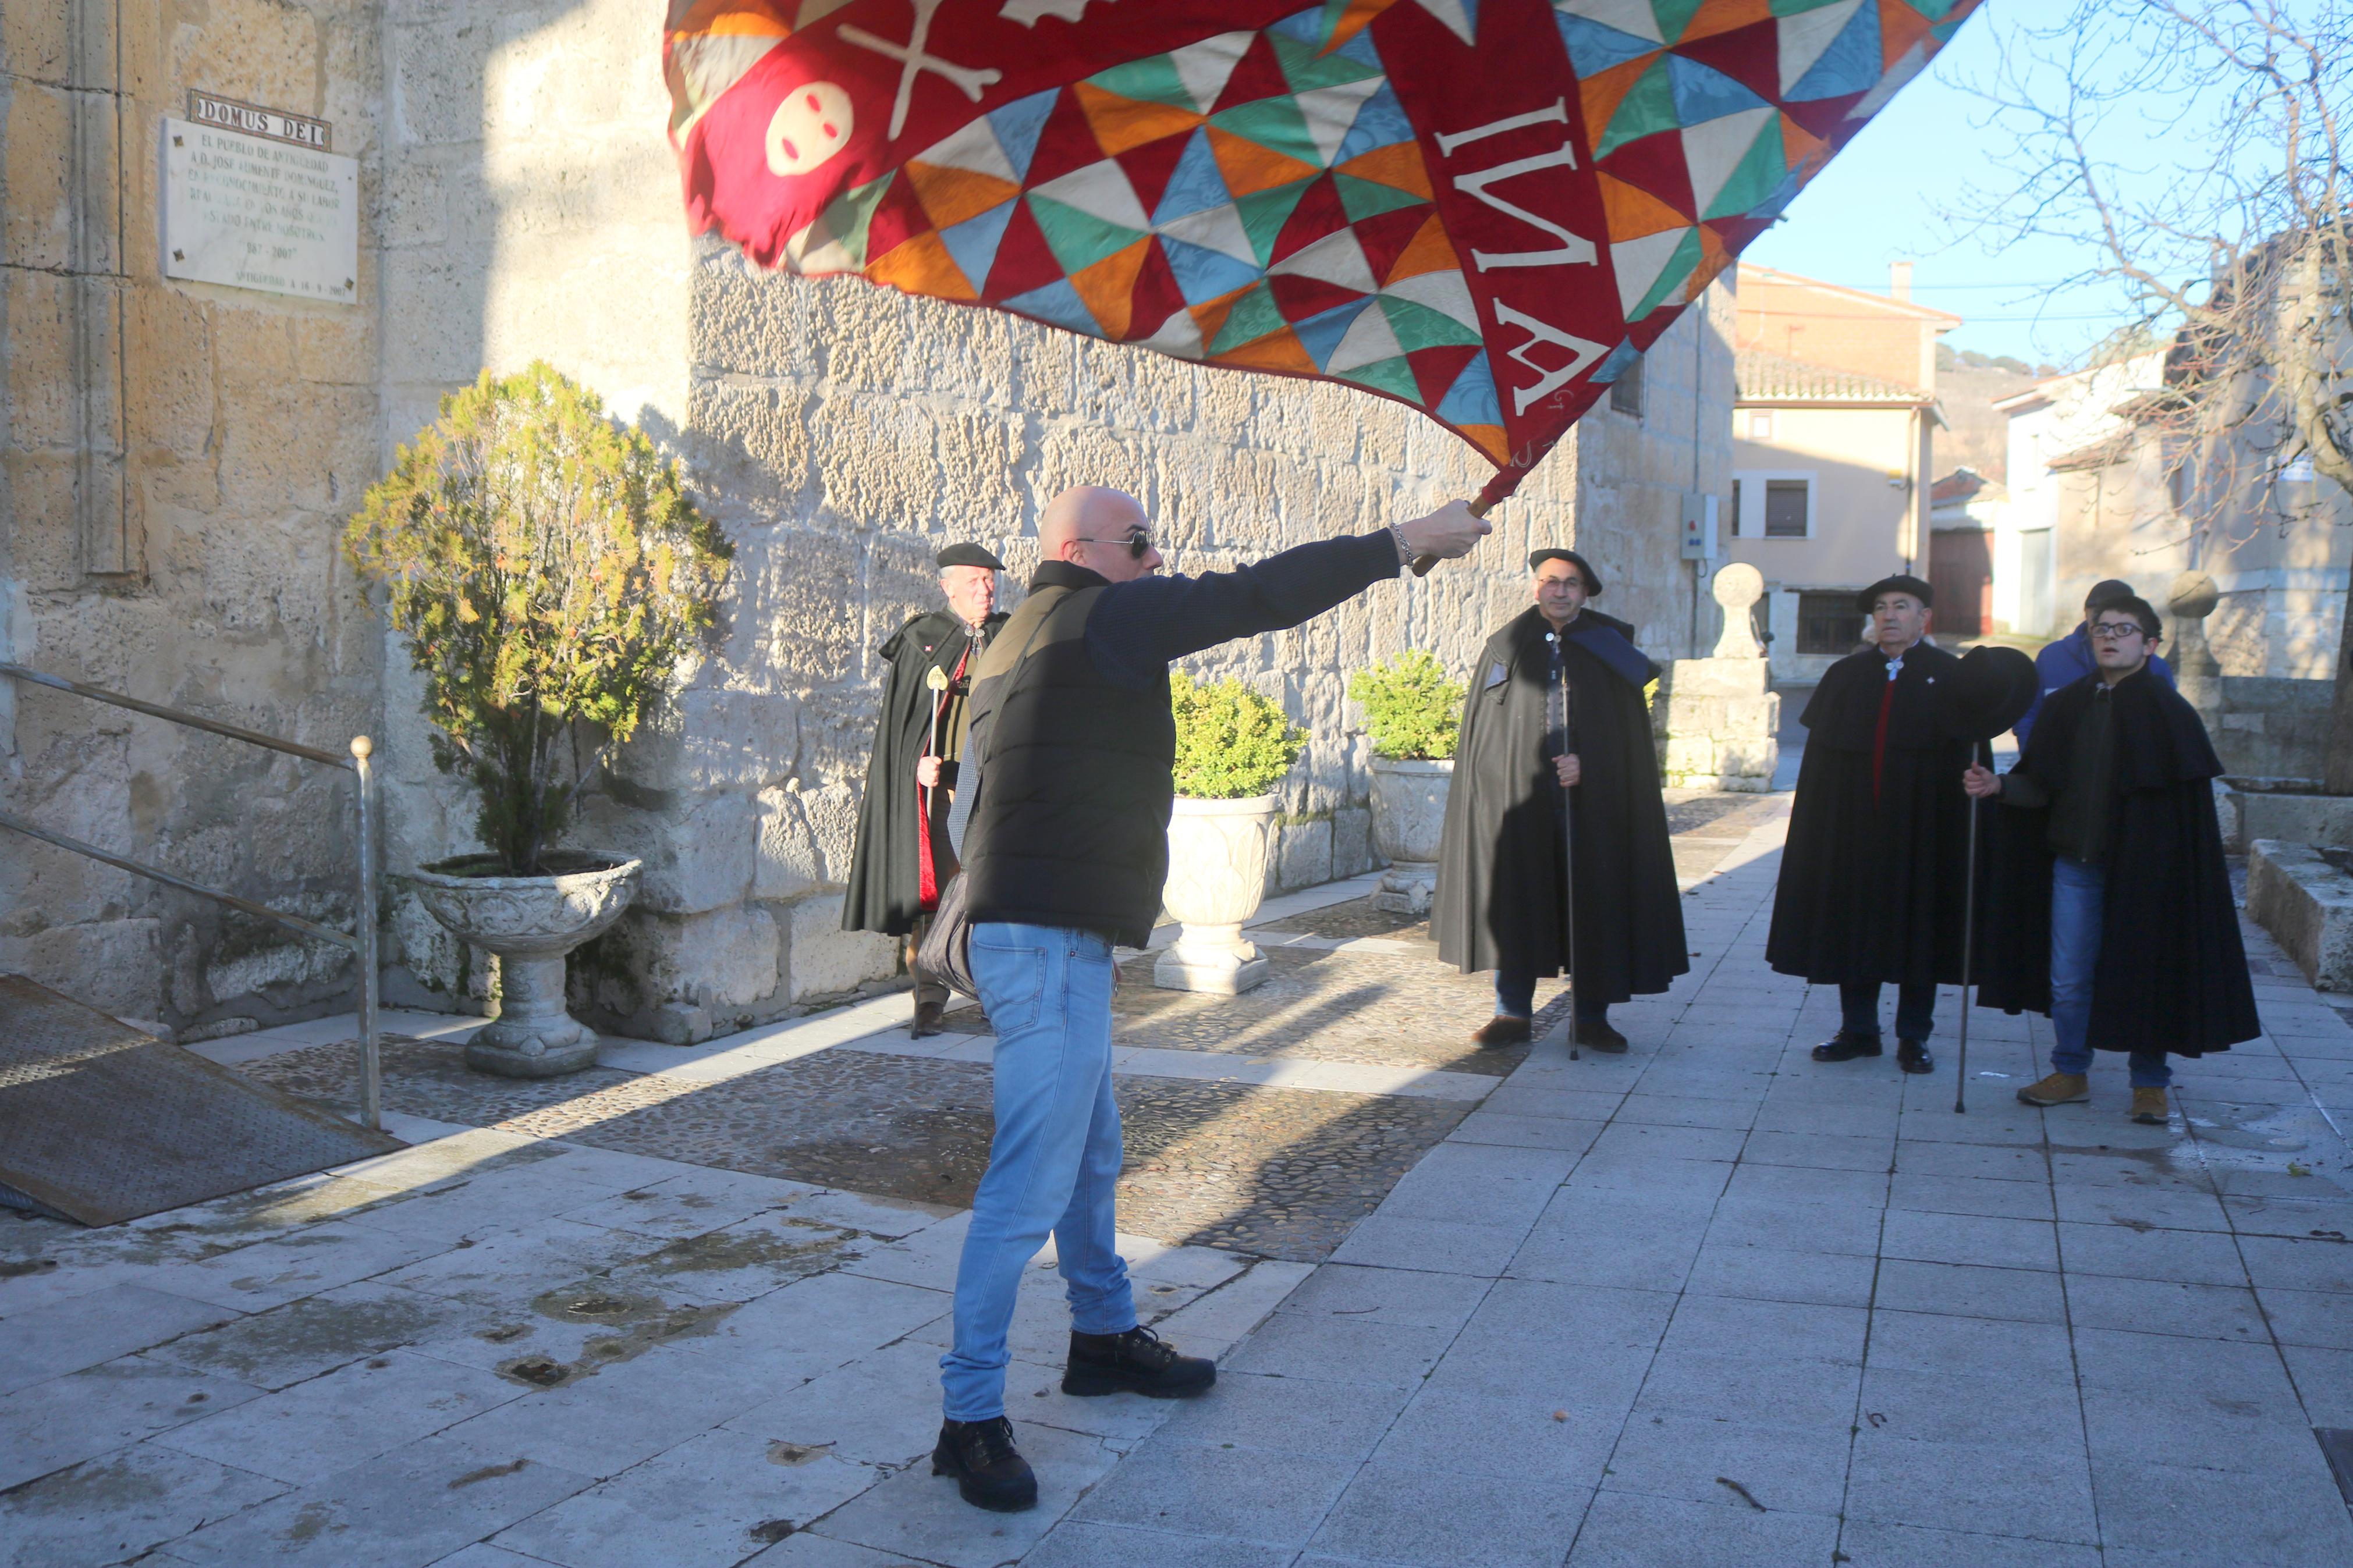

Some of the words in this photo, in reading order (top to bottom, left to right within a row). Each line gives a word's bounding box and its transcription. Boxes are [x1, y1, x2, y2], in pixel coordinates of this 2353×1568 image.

[204, 101, 268, 132] DOMUS
[283, 120, 317, 144] DEI
[201, 133, 212, 148] EL
[217, 137, 254, 157] PUEBLO
[257, 145, 269, 160] DE
[191, 150, 196, 162] A
[200, 151, 210, 165] D.
[285, 169, 338, 194] DOMNGUEZ,
[289, 188, 294, 201] A
[290, 278, 295, 289] A
